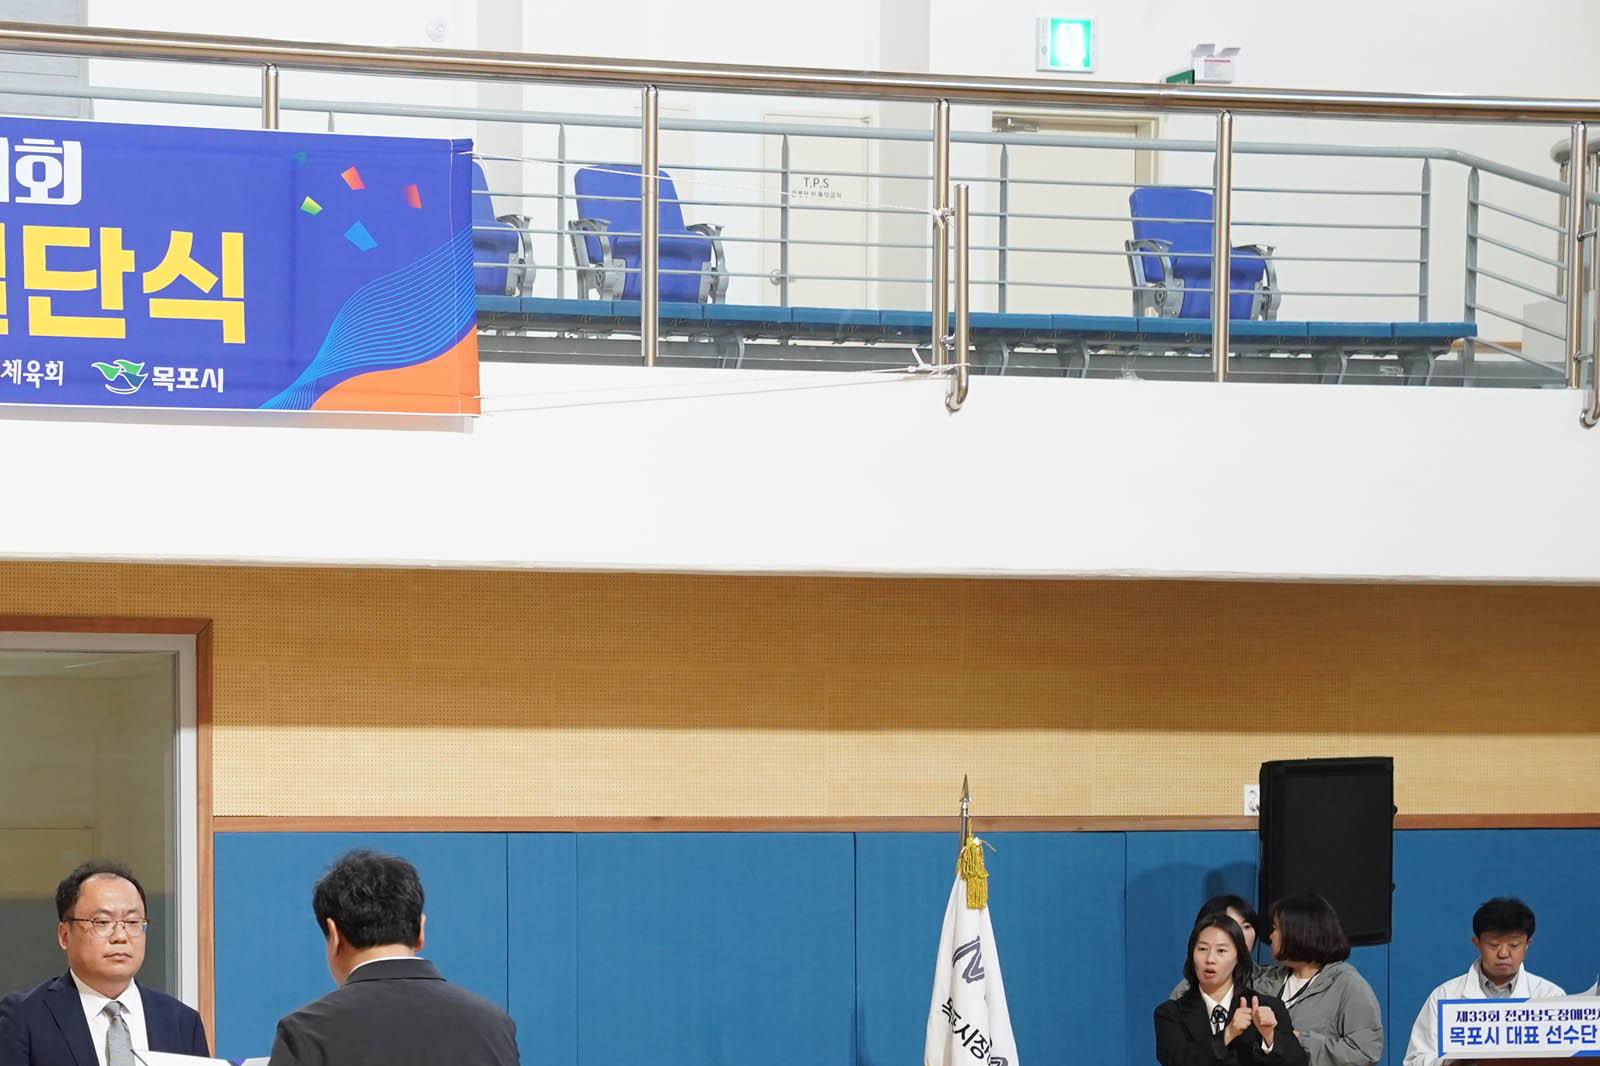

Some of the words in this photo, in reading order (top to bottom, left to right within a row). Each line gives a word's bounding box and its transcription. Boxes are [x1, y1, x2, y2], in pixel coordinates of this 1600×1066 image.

[151, 366, 225, 393] 목포시
[1455, 1009, 1500, 1023] 제33회
[1504, 1008, 1600, 1023] 전라남도장애인
[1449, 1026, 1500, 1046] 목포시
[1506, 1025, 1540, 1045] 대표
[1545, 1024, 1598, 1045] 선수단
